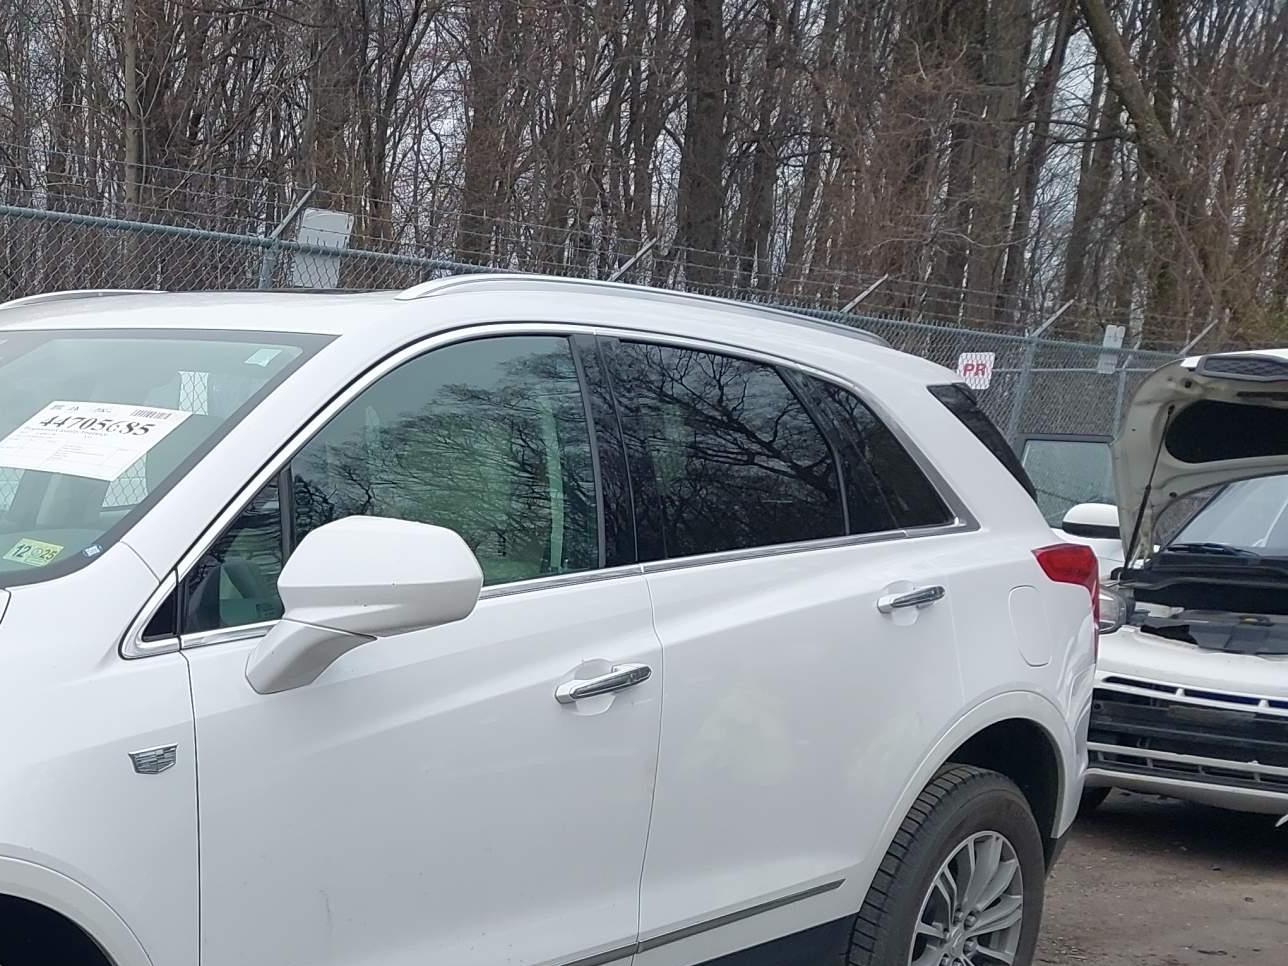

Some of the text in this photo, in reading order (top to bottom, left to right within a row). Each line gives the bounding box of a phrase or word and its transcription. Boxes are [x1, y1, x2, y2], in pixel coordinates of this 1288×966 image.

[963, 363, 986, 376] PR
[40, 414, 156, 436] 44705685
[13, 543, 57, 560] 12 25
